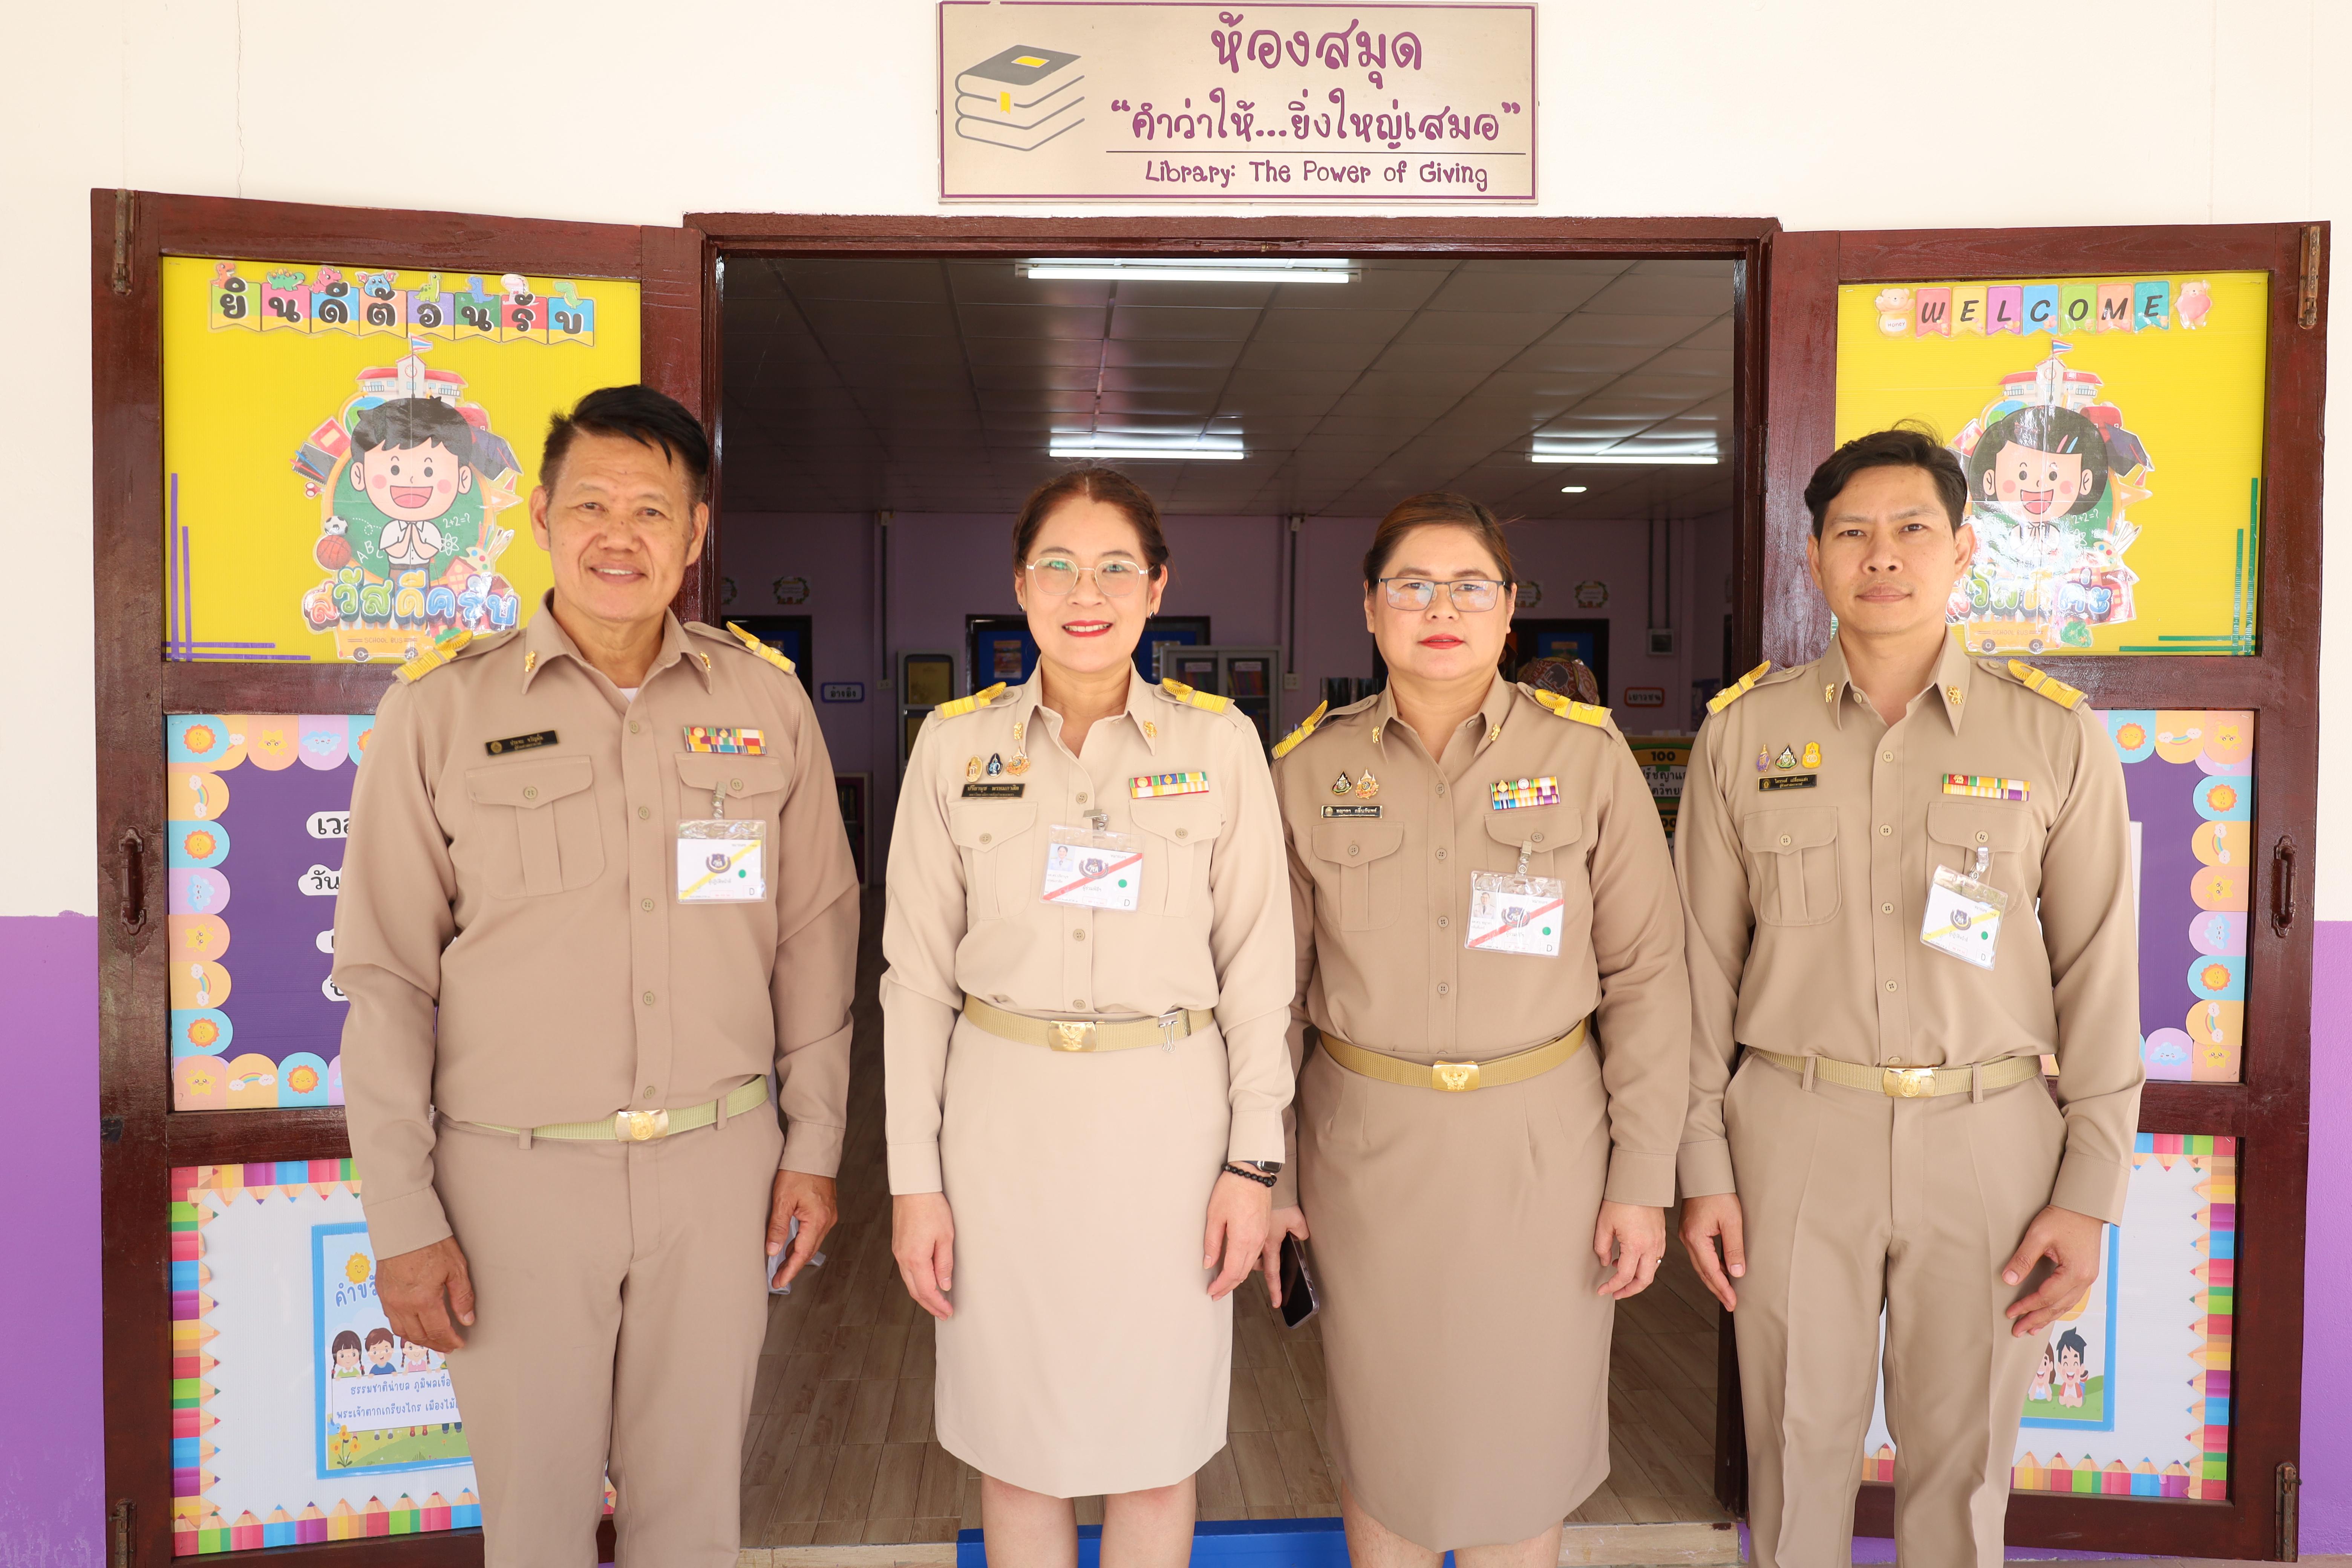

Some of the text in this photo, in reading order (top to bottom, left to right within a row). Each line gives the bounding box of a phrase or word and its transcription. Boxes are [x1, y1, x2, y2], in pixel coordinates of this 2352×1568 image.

[1211, 11, 1422, 89] ห้องสมุด
[1145, 159, 1488, 192] Library: The Power of Giving
[219, 277, 583, 334] ยินดีต้อนรับ
[1922, 294, 2163, 324] WELCOME
[443, 513, 470, 528] 2+2=?
[2072, 508, 2099, 524] 2+2=?
[304, 566, 519, 627] สวัสดีครับ
[1651, 750, 1676, 762] 100
[350, 1381, 410, 1395] ธรรมชาติน่ายล
[336, 1402, 421, 1419] พระเจ้าตากเกรียงไกร
